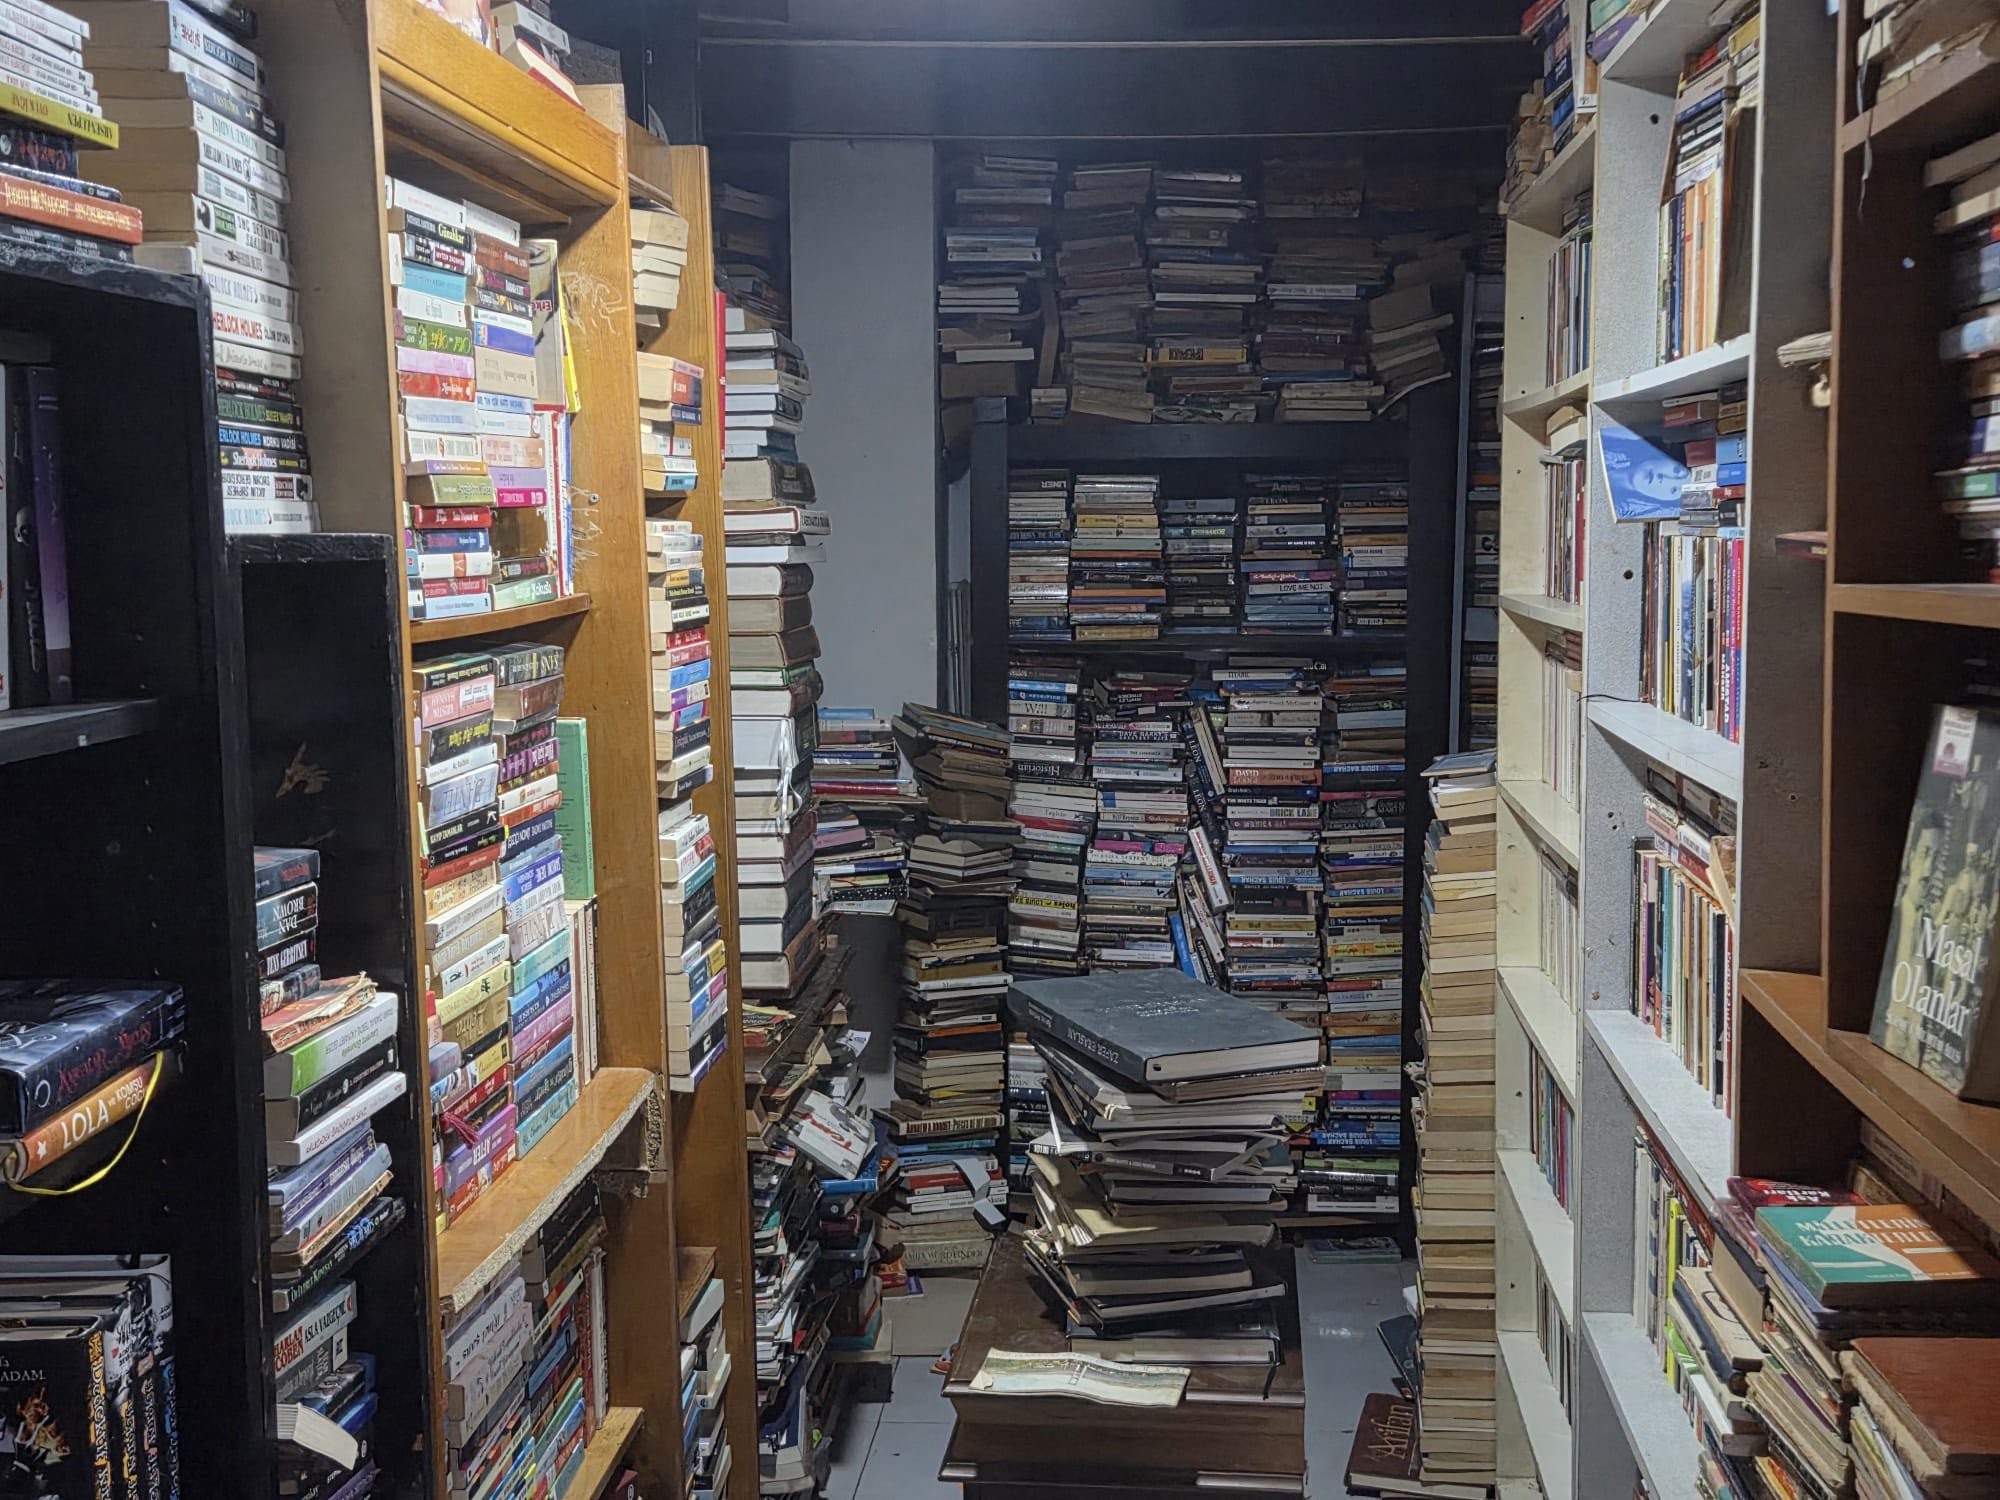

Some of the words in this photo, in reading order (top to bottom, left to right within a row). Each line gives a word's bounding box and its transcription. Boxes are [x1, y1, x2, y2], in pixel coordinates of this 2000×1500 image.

[1279, 582, 1297, 592] LOVE
[1298, 582, 1309, 592] ME
[1310, 582, 1324, 592] NOT
[272, 895, 305, 917] BROWN
[279, 914, 298, 935] DAN
[1917, 915, 1984, 984] Masal
[1890, 960, 1971, 1038] Olanlar
[60, 1098, 110, 1150] LOLA
[471, 1136, 493, 1166] AFTER
[274, 1339, 304, 1373] COBEN
